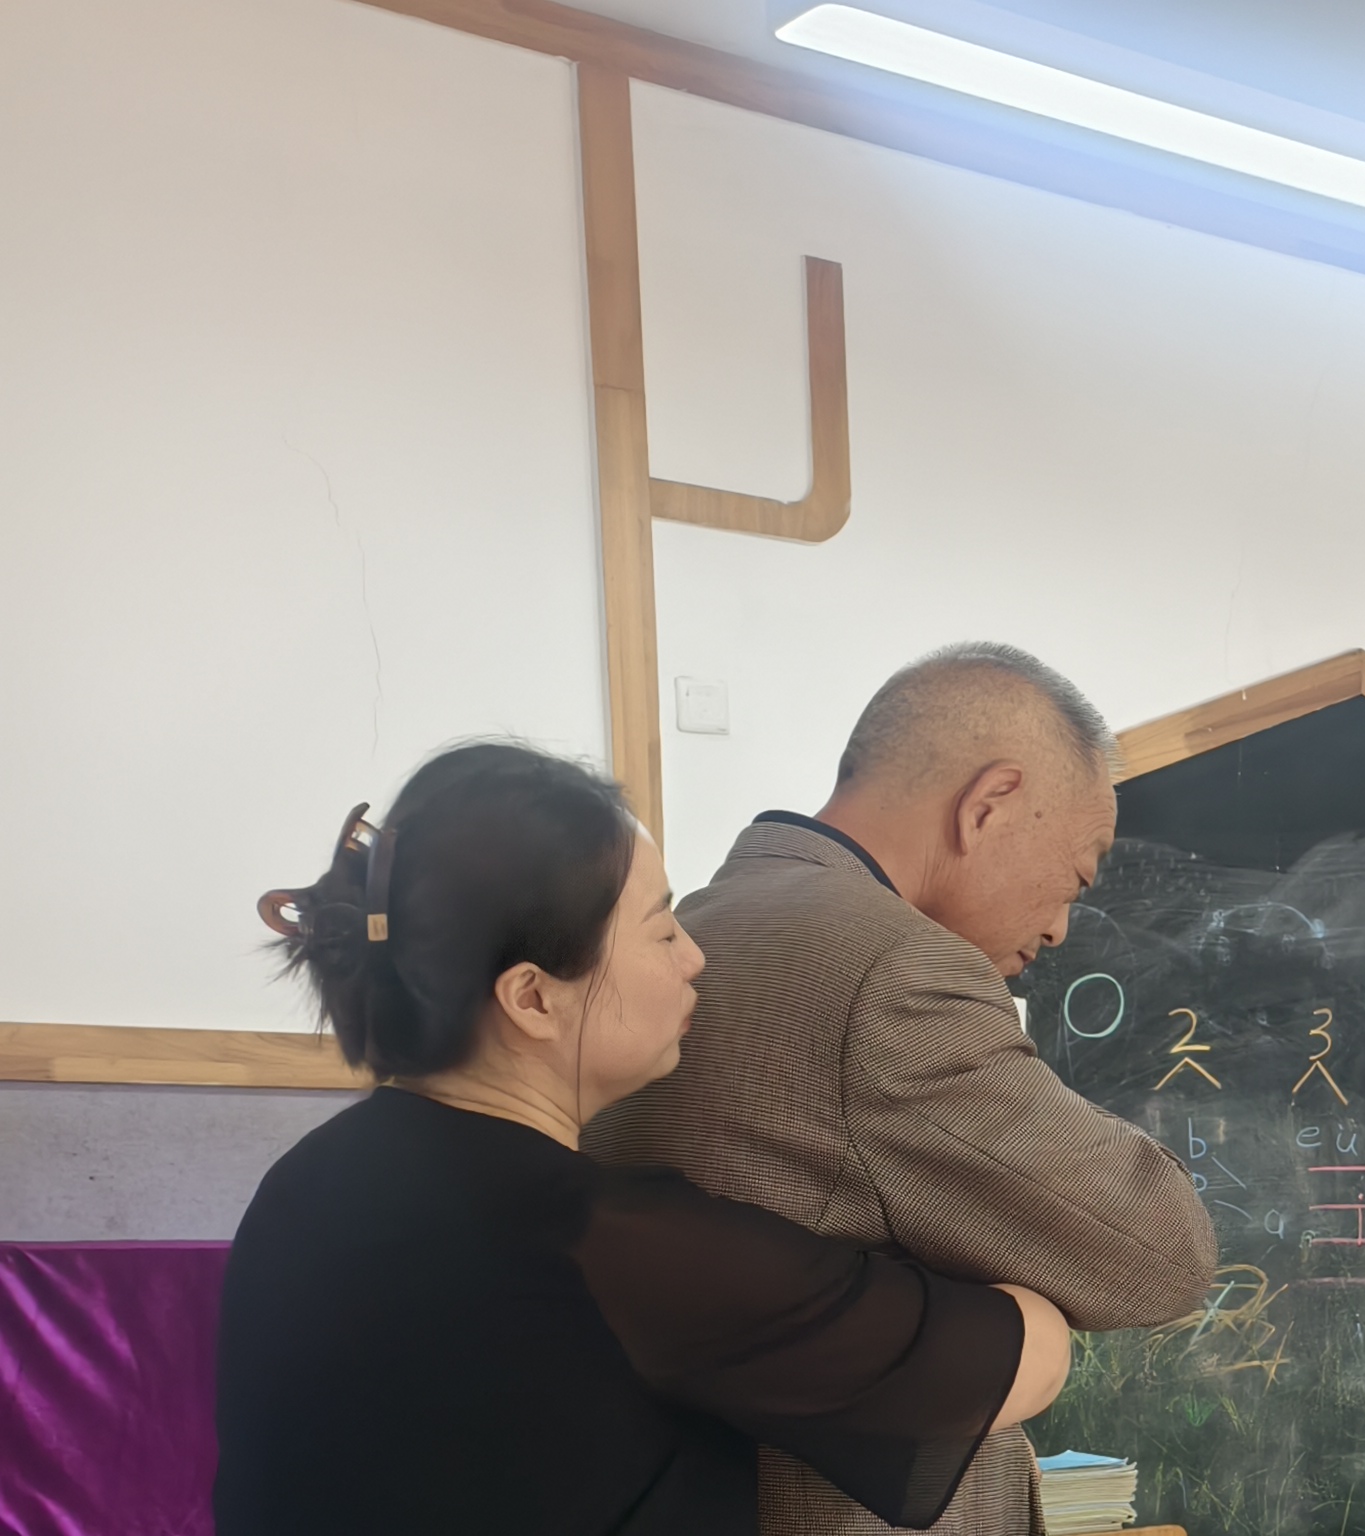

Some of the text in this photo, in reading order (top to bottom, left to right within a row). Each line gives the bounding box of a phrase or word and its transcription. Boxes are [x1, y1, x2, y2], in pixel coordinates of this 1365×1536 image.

[1168, 1007, 1211, 1054] 2
[1309, 1007, 1333, 1061] 3
[1188, 1117, 1207, 1159] b
